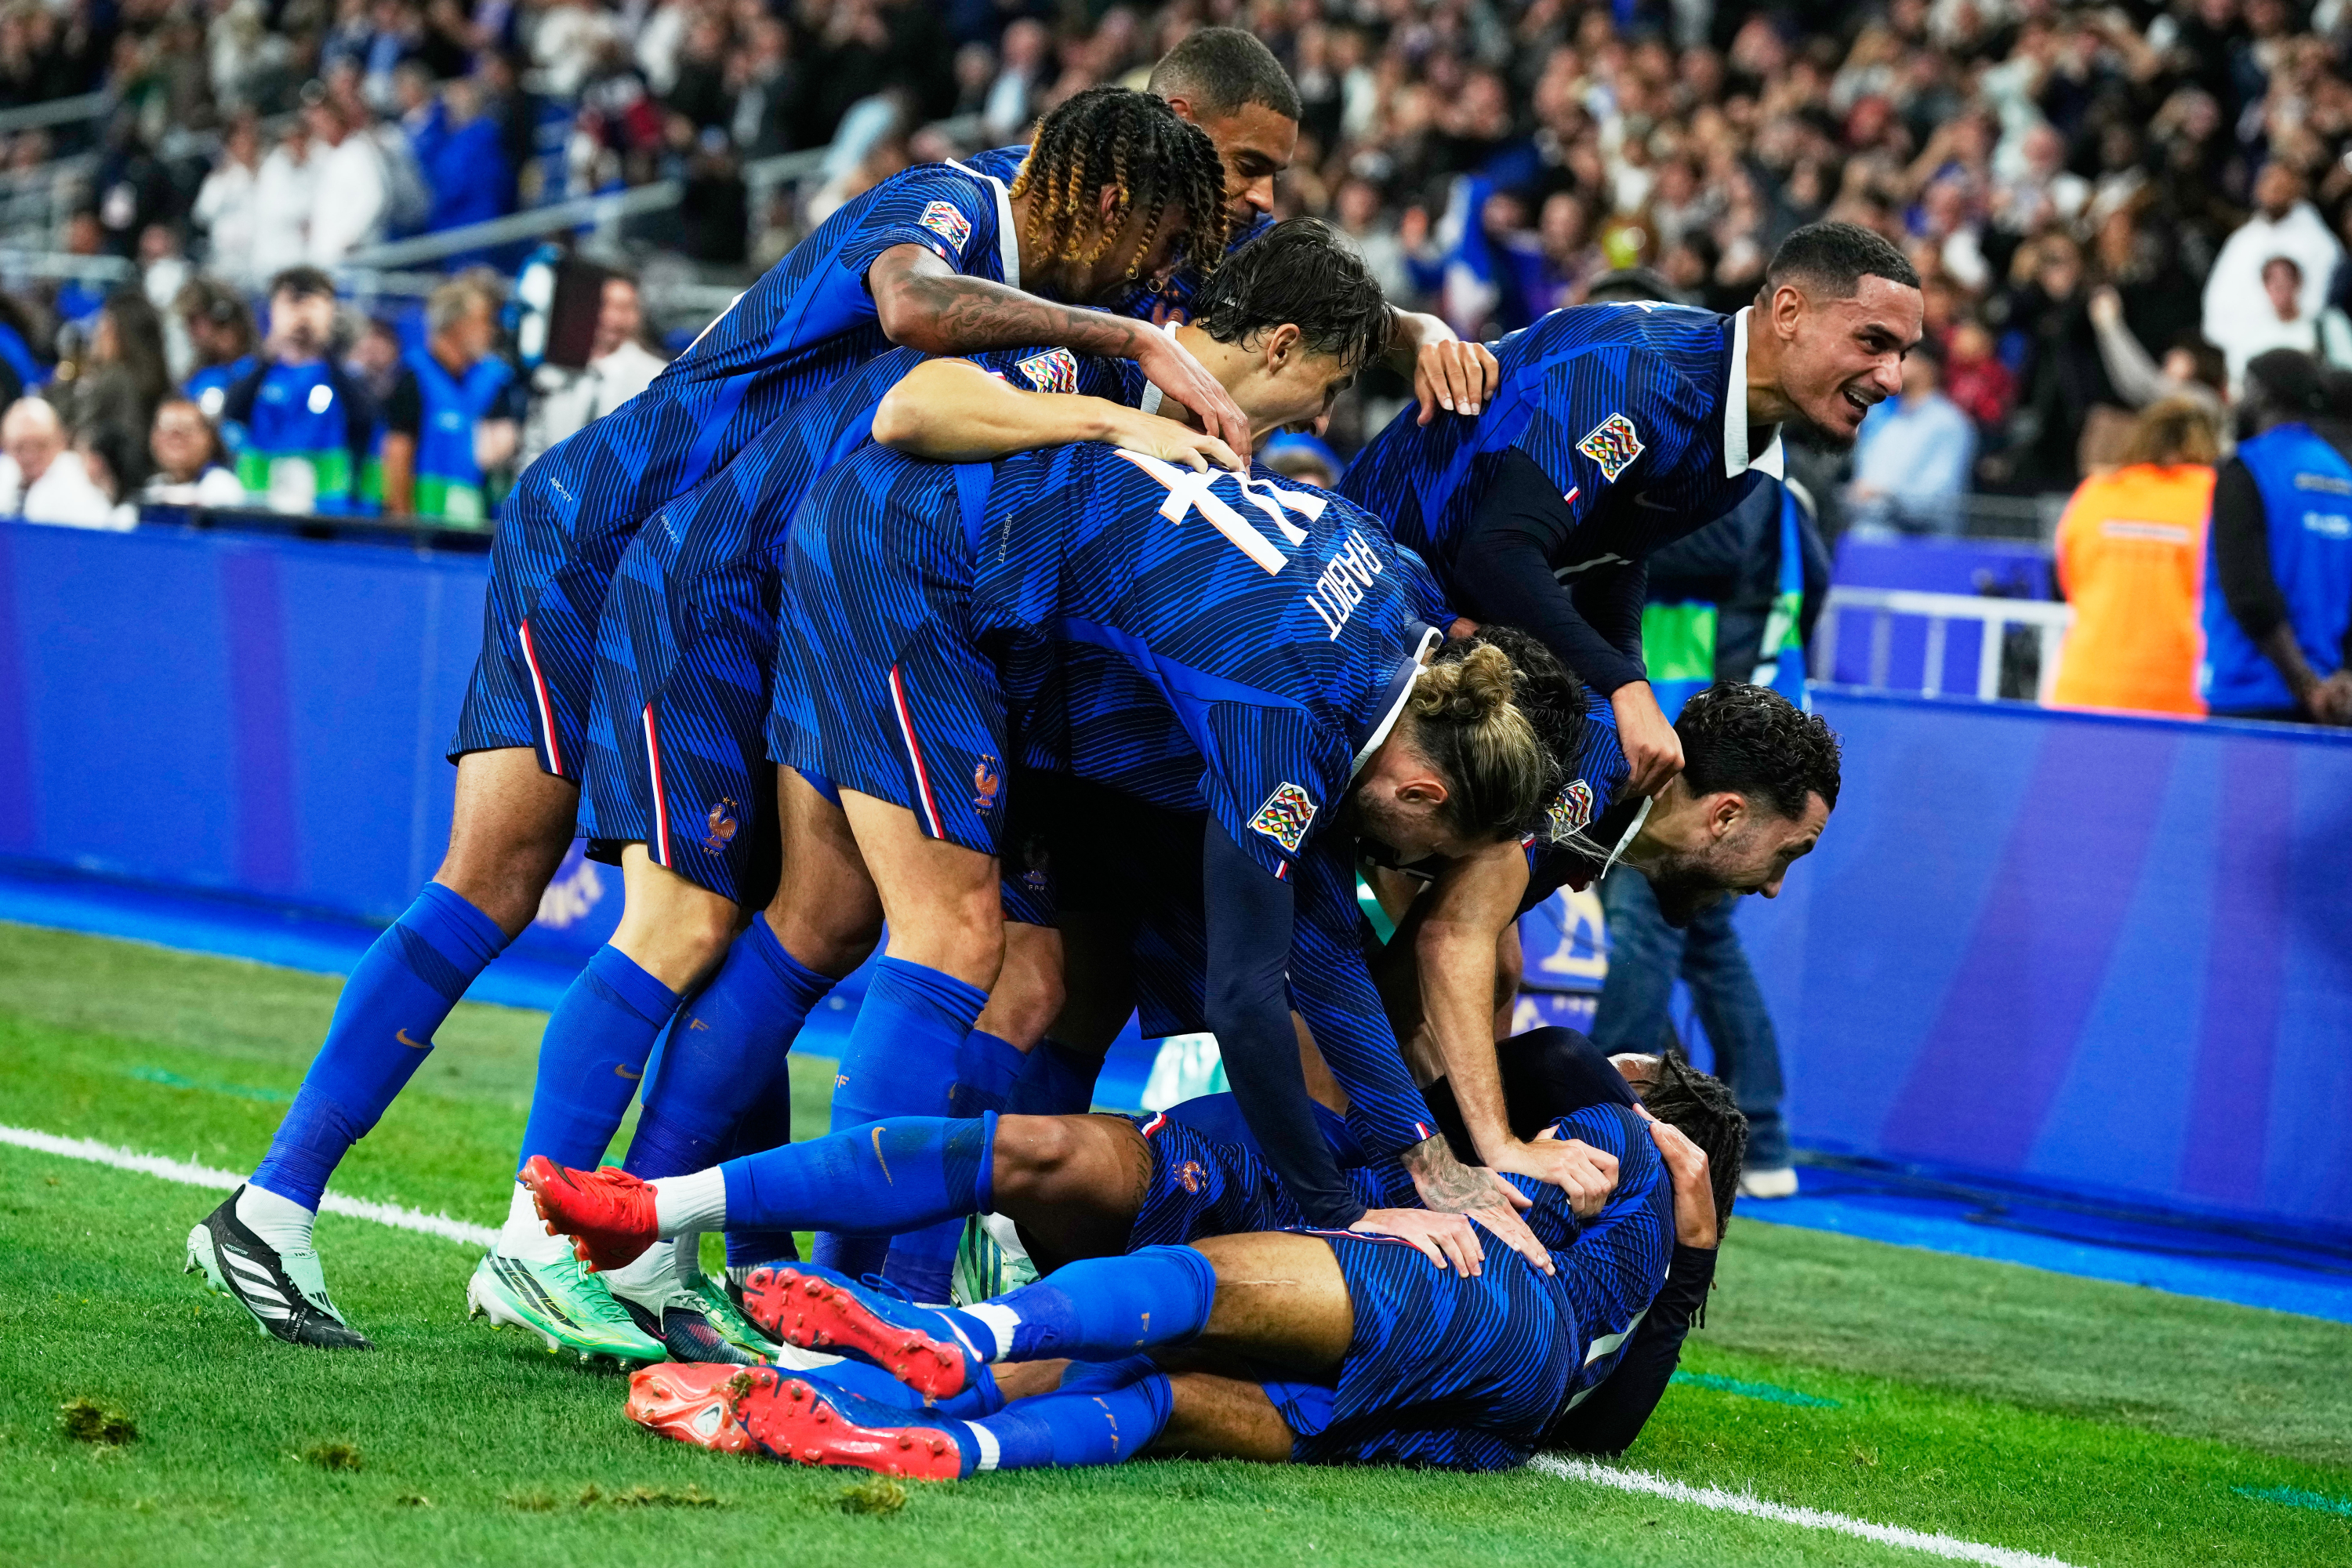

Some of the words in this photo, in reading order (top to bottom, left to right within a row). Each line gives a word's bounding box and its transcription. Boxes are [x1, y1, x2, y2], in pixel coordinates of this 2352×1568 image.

[997, 512, 1013, 564] AERO-FIT
[1305, 528, 1384, 642] RABIOT
[224, 1243, 249, 1256] PREDATOR
